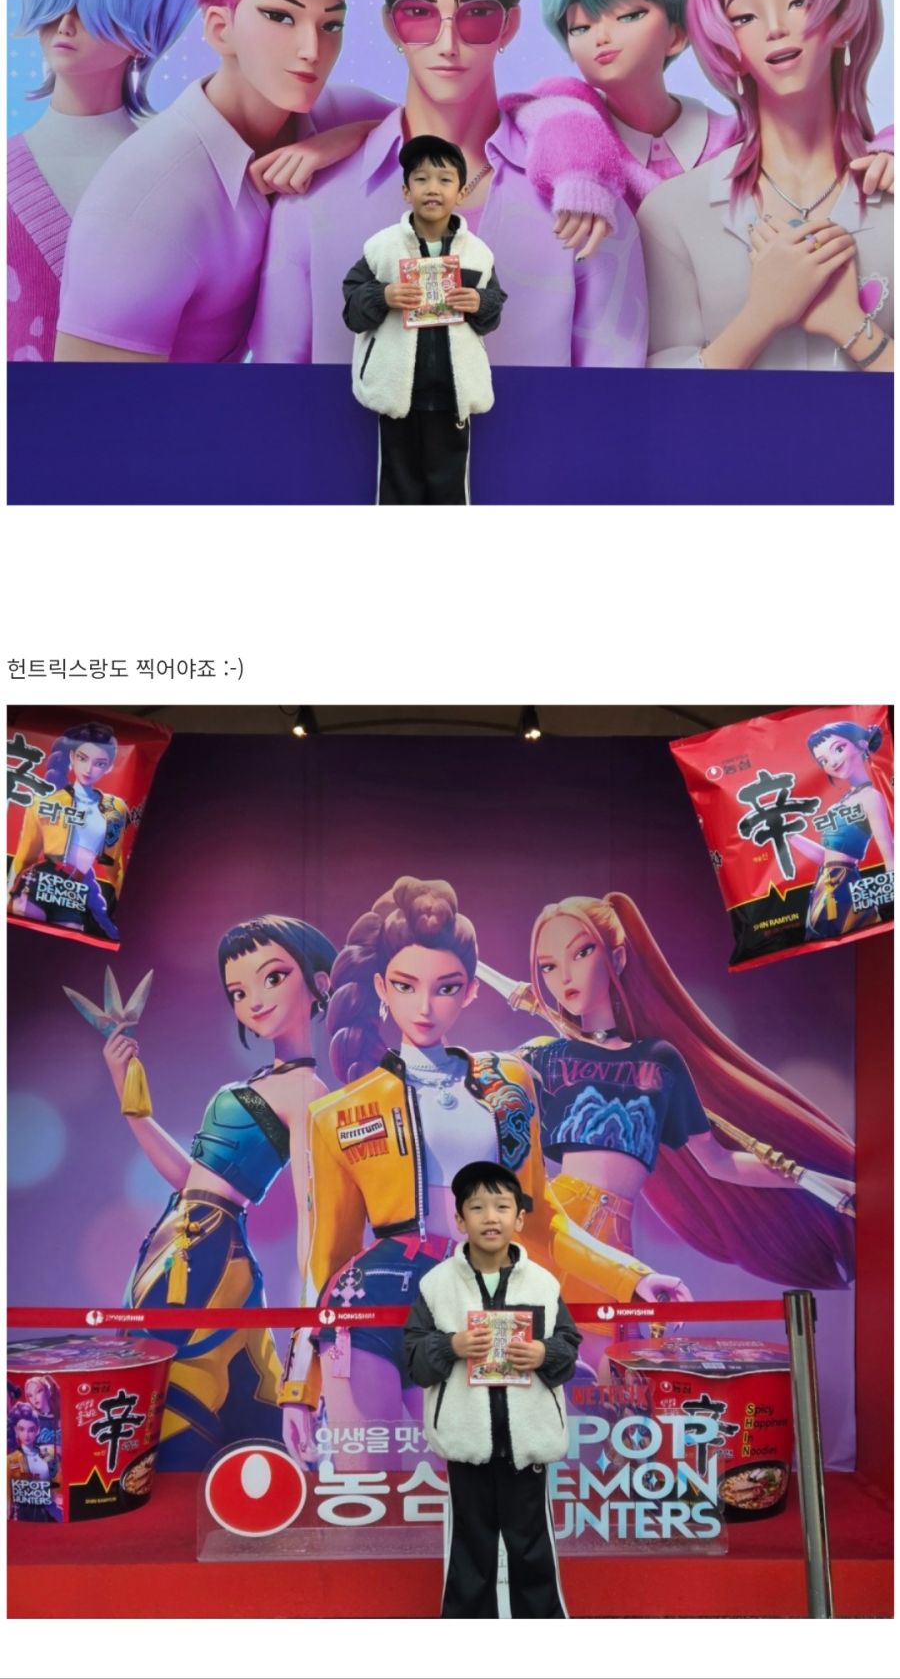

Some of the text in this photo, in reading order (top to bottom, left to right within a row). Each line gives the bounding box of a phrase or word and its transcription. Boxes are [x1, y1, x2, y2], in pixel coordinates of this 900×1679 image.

[38, 800, 87, 828] 라면
[737, 768, 822, 881] 辛
[813, 803, 866, 833] 라면
[37, 881, 87, 906] DEMON
[38, 871, 90, 893] K-POP
[35, 891, 87, 912] HUNTERS
[753, 913, 800, 931] SHIN RAMYUN
[571, 1384, 649, 1406] NETFLIX
[745, 1403, 775, 1416] Spicy
[90, 1387, 145, 1474] 辛
[315, 1426, 390, 1455] 인생을
[549, 1453, 719, 1506] EMON
[556, 1501, 722, 1543] UNTERS
